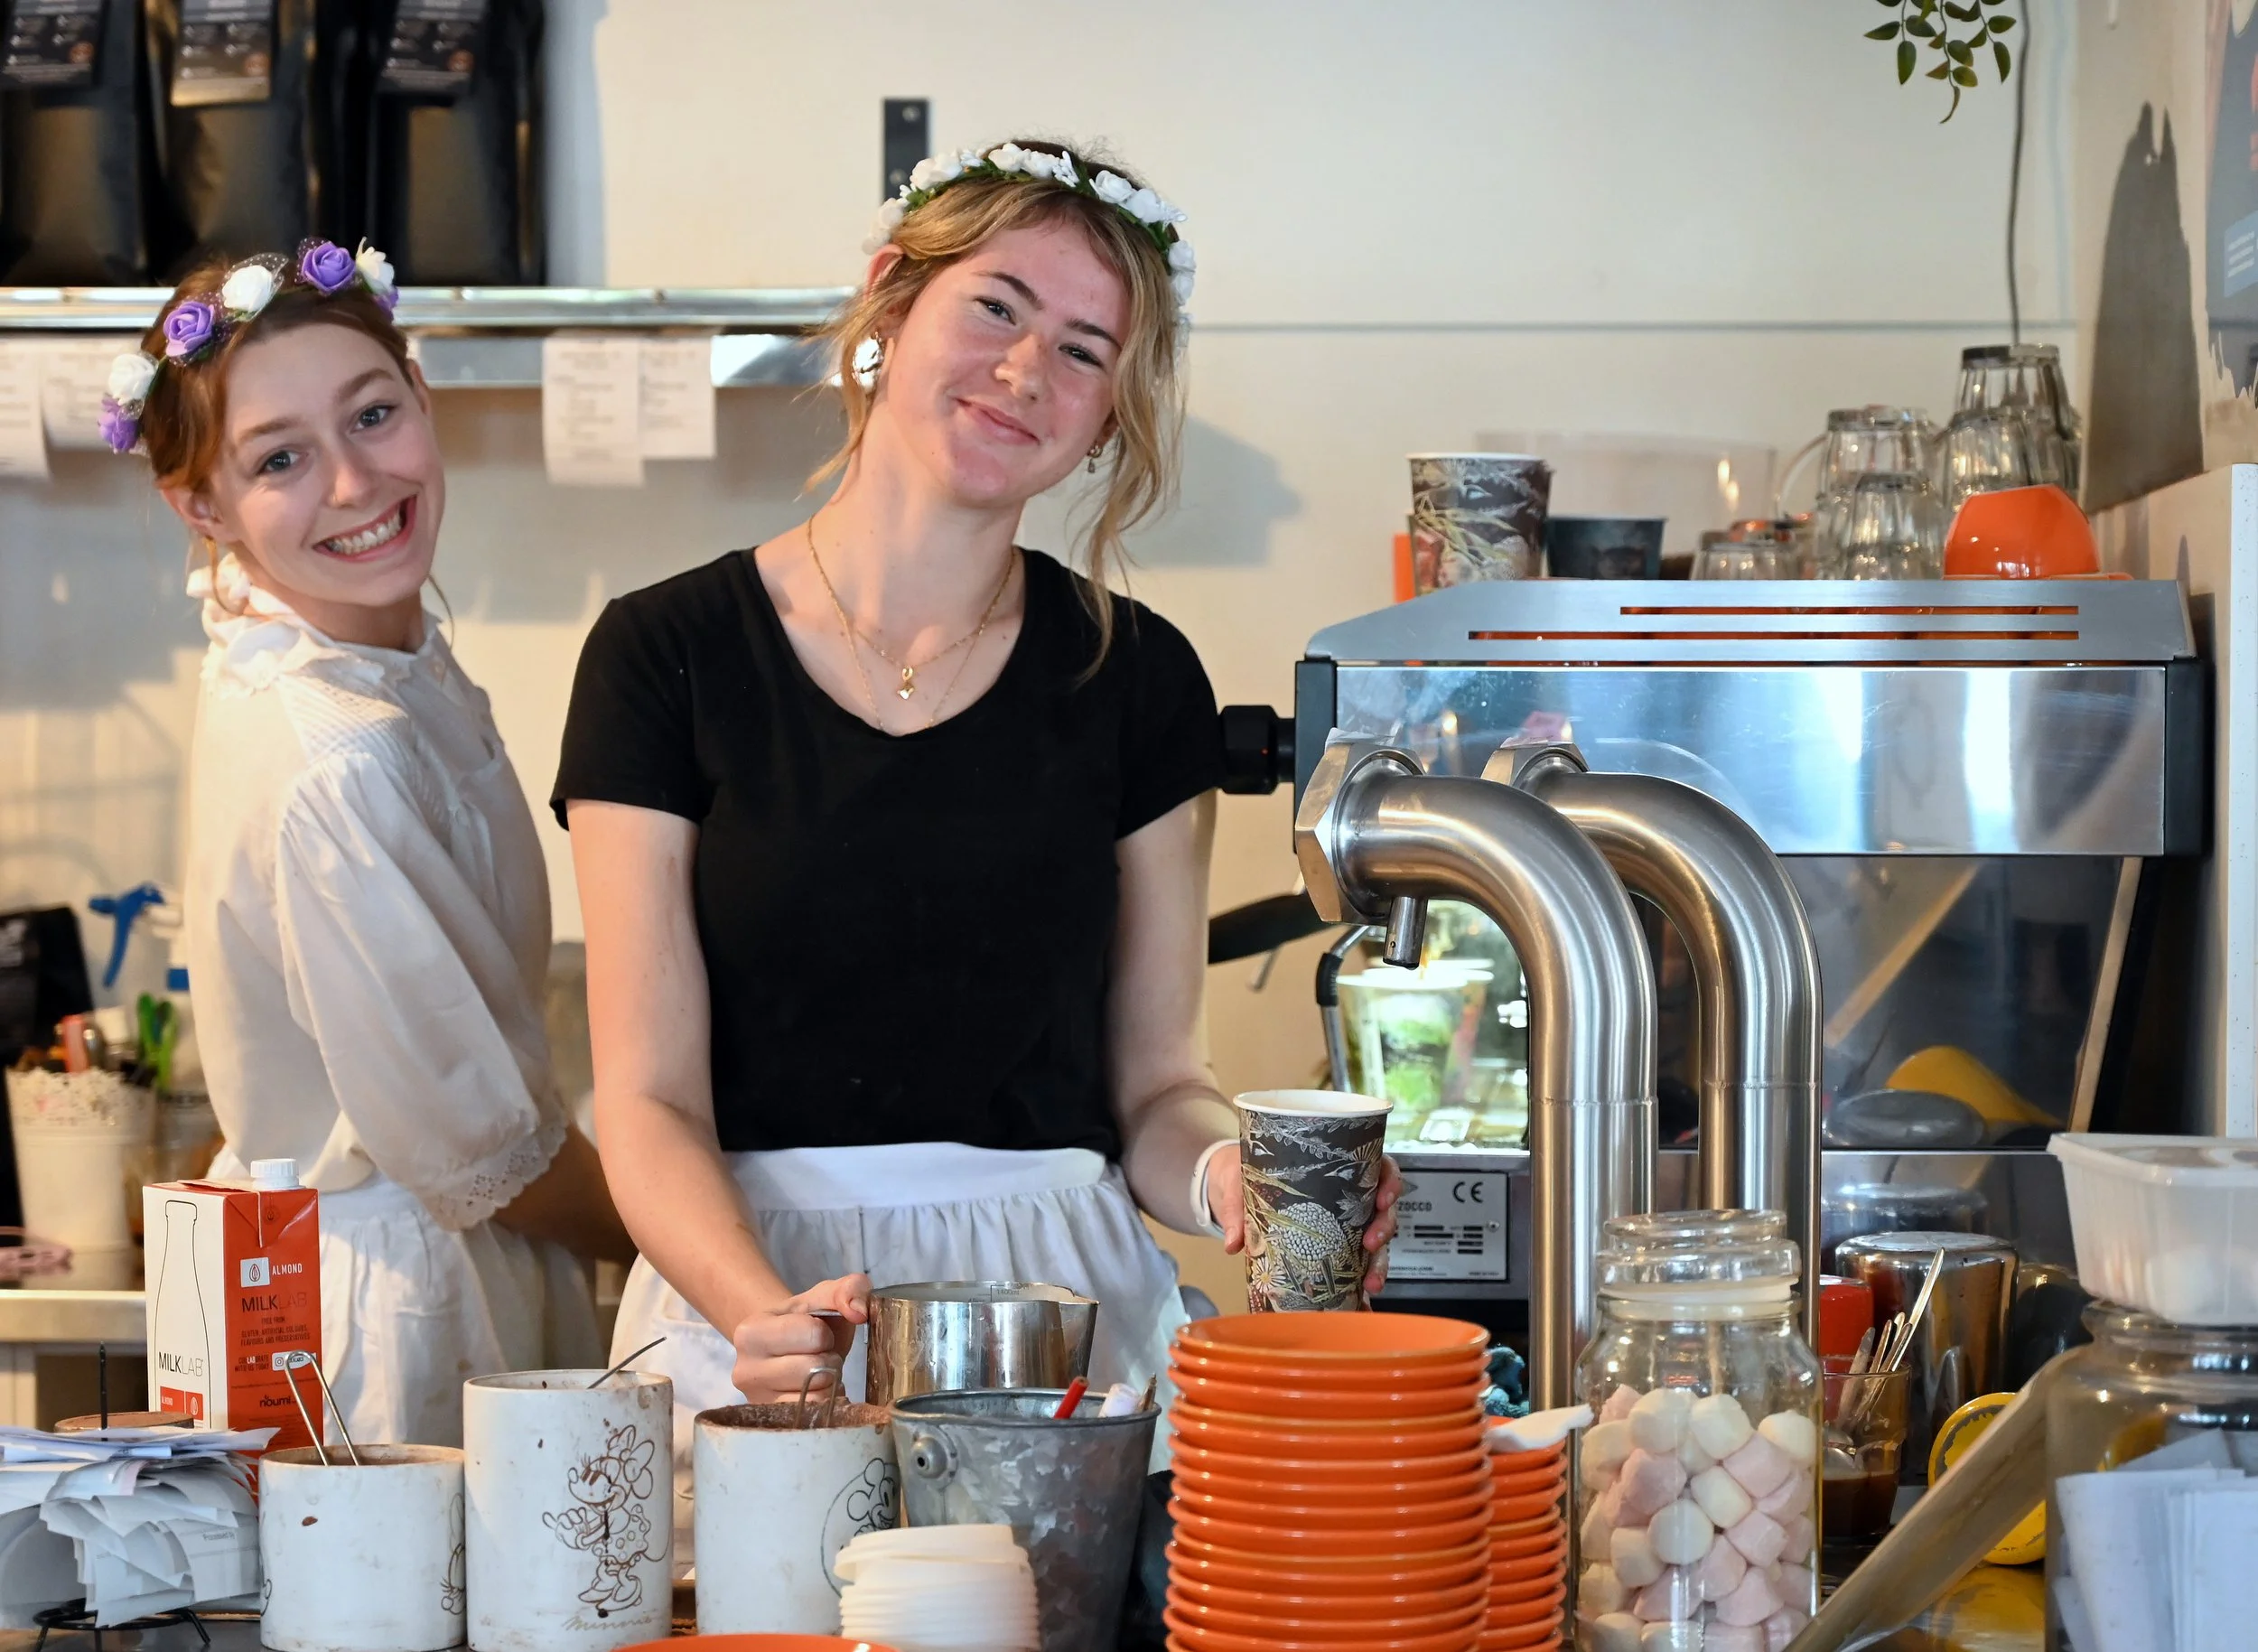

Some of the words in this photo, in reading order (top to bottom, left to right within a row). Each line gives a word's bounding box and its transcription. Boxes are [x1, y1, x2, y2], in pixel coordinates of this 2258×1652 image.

[1398, 1201, 1432, 1212] ZOCCO
[272, 1263, 303, 1275] ALMOND
[241, 1292, 307, 1312] MILKLAB
[159, 1351, 203, 1377] MILKLAB
[259, 1395, 291, 1407] noumi
